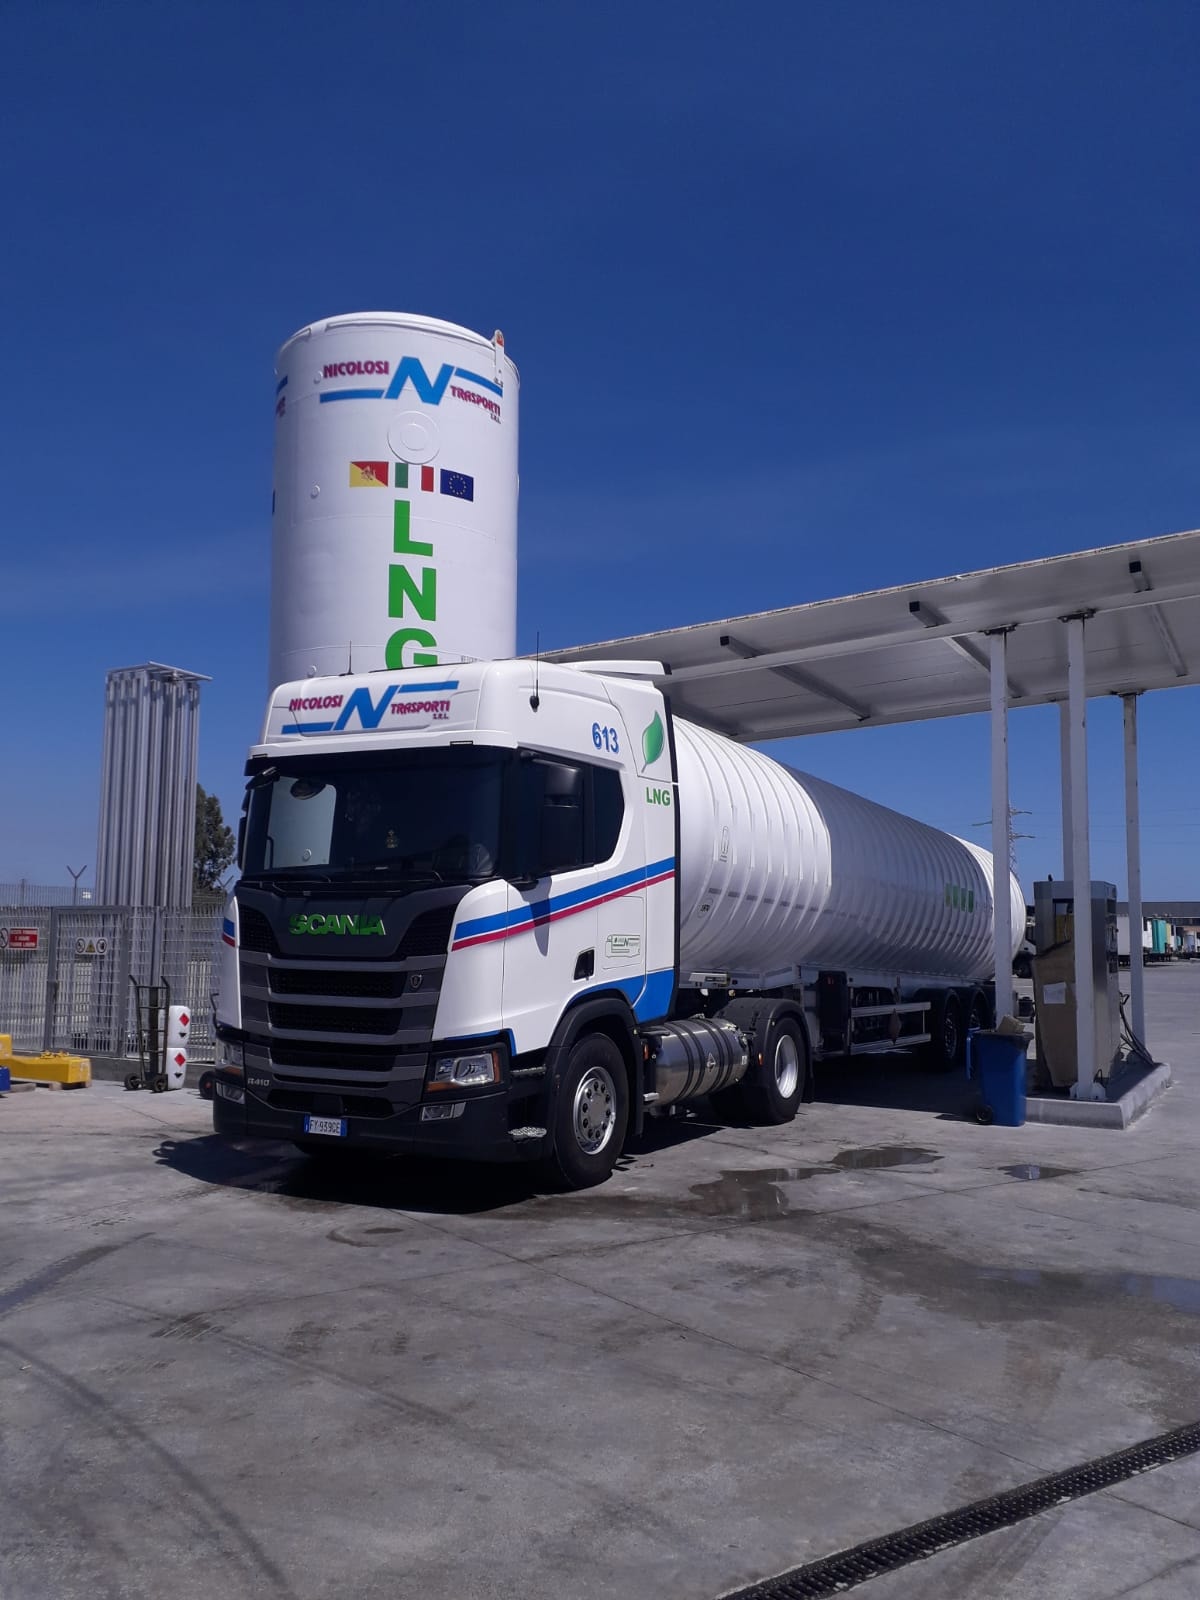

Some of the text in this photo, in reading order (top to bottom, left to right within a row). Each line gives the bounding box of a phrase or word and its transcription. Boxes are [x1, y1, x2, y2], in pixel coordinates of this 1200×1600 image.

[323, 360, 390, 379] NICOLOSI
[450, 385, 501, 417] TRASPORTI
[385, 499, 438, 670] LNG
[289, 695, 344, 712] NICOLOSI
[391, 700, 450, 714] TRASPORTI
[592, 722, 619, 754] 613
[646, 787, 671, 806] LNG
[289, 913, 386, 936] SCANIA
